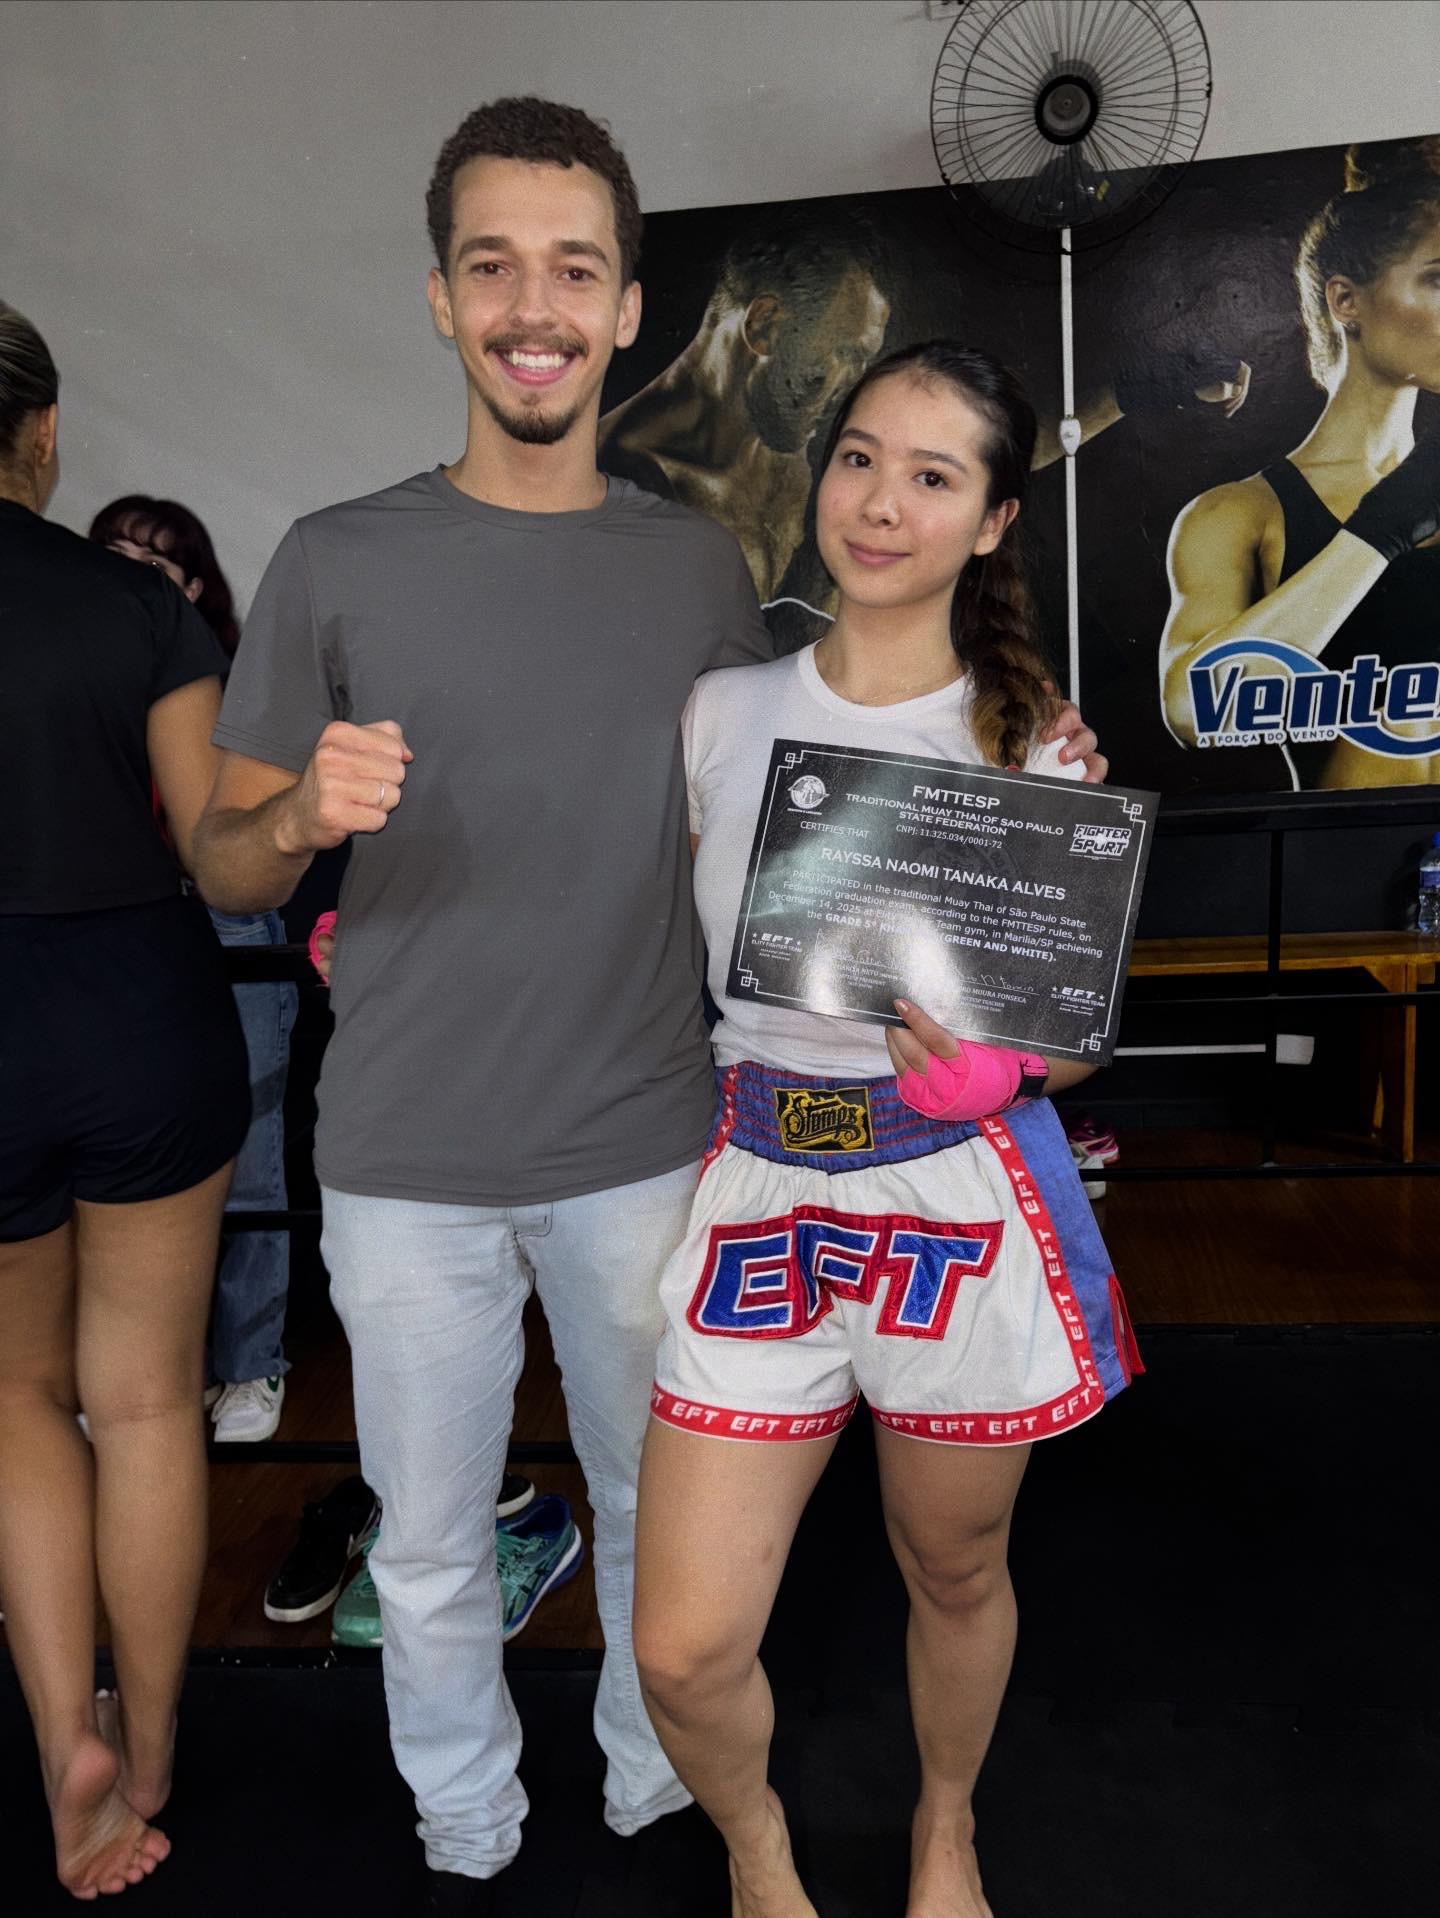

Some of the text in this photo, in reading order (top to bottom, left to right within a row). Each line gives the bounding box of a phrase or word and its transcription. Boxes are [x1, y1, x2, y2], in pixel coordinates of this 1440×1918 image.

[1200, 729, 1335, 745] A FORÇA DO VENTO
[845, 793, 1064, 836] TRADITIONAL MUAY THAI OF SAO PAULO
[912, 785, 1000, 810] FMTTESP
[800, 820, 870, 839] CERTIFIES THAT
[896, 825, 1002, 849] CNPJ: 11.325.034/0001-72
[899, 811, 1007, 836] STATE FEDERATION
[1073, 824, 1131, 839] FIGHTER
[1072, 838, 1127, 854] SPORT
[821, 848, 1067, 900] RAYSSA NAOMI TANAKA ALVES
[834, 890, 885, 905] graduation
[920, 905, 967, 922] according
[969, 914, 979, 923] to
[982, 915, 999, 926] the
[1001, 918, 1046, 933] FMTTESP
[1048, 928, 1076, 942] rules,
[1078, 933, 1092, 942] on
[863, 882, 872, 891] in
[875, 884, 891, 894] the
[893, 888, 942, 903] traditional
[944, 896, 970, 910] Muay
[973, 901, 994, 913] Thai
[996, 904, 1006, 914] of
[1009, 907, 1027, 918] São
[1030, 911, 1057, 923] Paulo
[1060, 916, 1087, 929] State
[761, 933, 794, 945] EFT
[807, 910, 822, 920] the
[825, 913, 862, 927] GRADE
[983, 940, 1008, 952] AND
[1011, 945, 1057, 962] WHITE).
[819, 899, 833, 910] 14,
[836, 902, 861, 914] 2025
[936, 920, 962, 932] Team
[964, 925, 989, 938] gym,
[992, 929, 1001, 938] in
[1004, 931, 1054, 948] Marilia/SP
[1056, 941, 1103, 959] achieving
[997, 993, 1027, 1004] FONSECA
[1061, 986, 1096, 999] EFT
[1011, 1168, 1041, 1216] EFT
[1037, 1228, 1062, 1278] EFT
[692, 1210, 998, 1335] EFT
[1056, 1291, 1084, 1341] EFT
[670, 1401, 720, 1425] EFT
[730, 1415, 780, 1435] EFT
[788, 1417, 828, 1435] EFT
[880, 1388, 1091, 1435] EFT EFT EFT EFT
